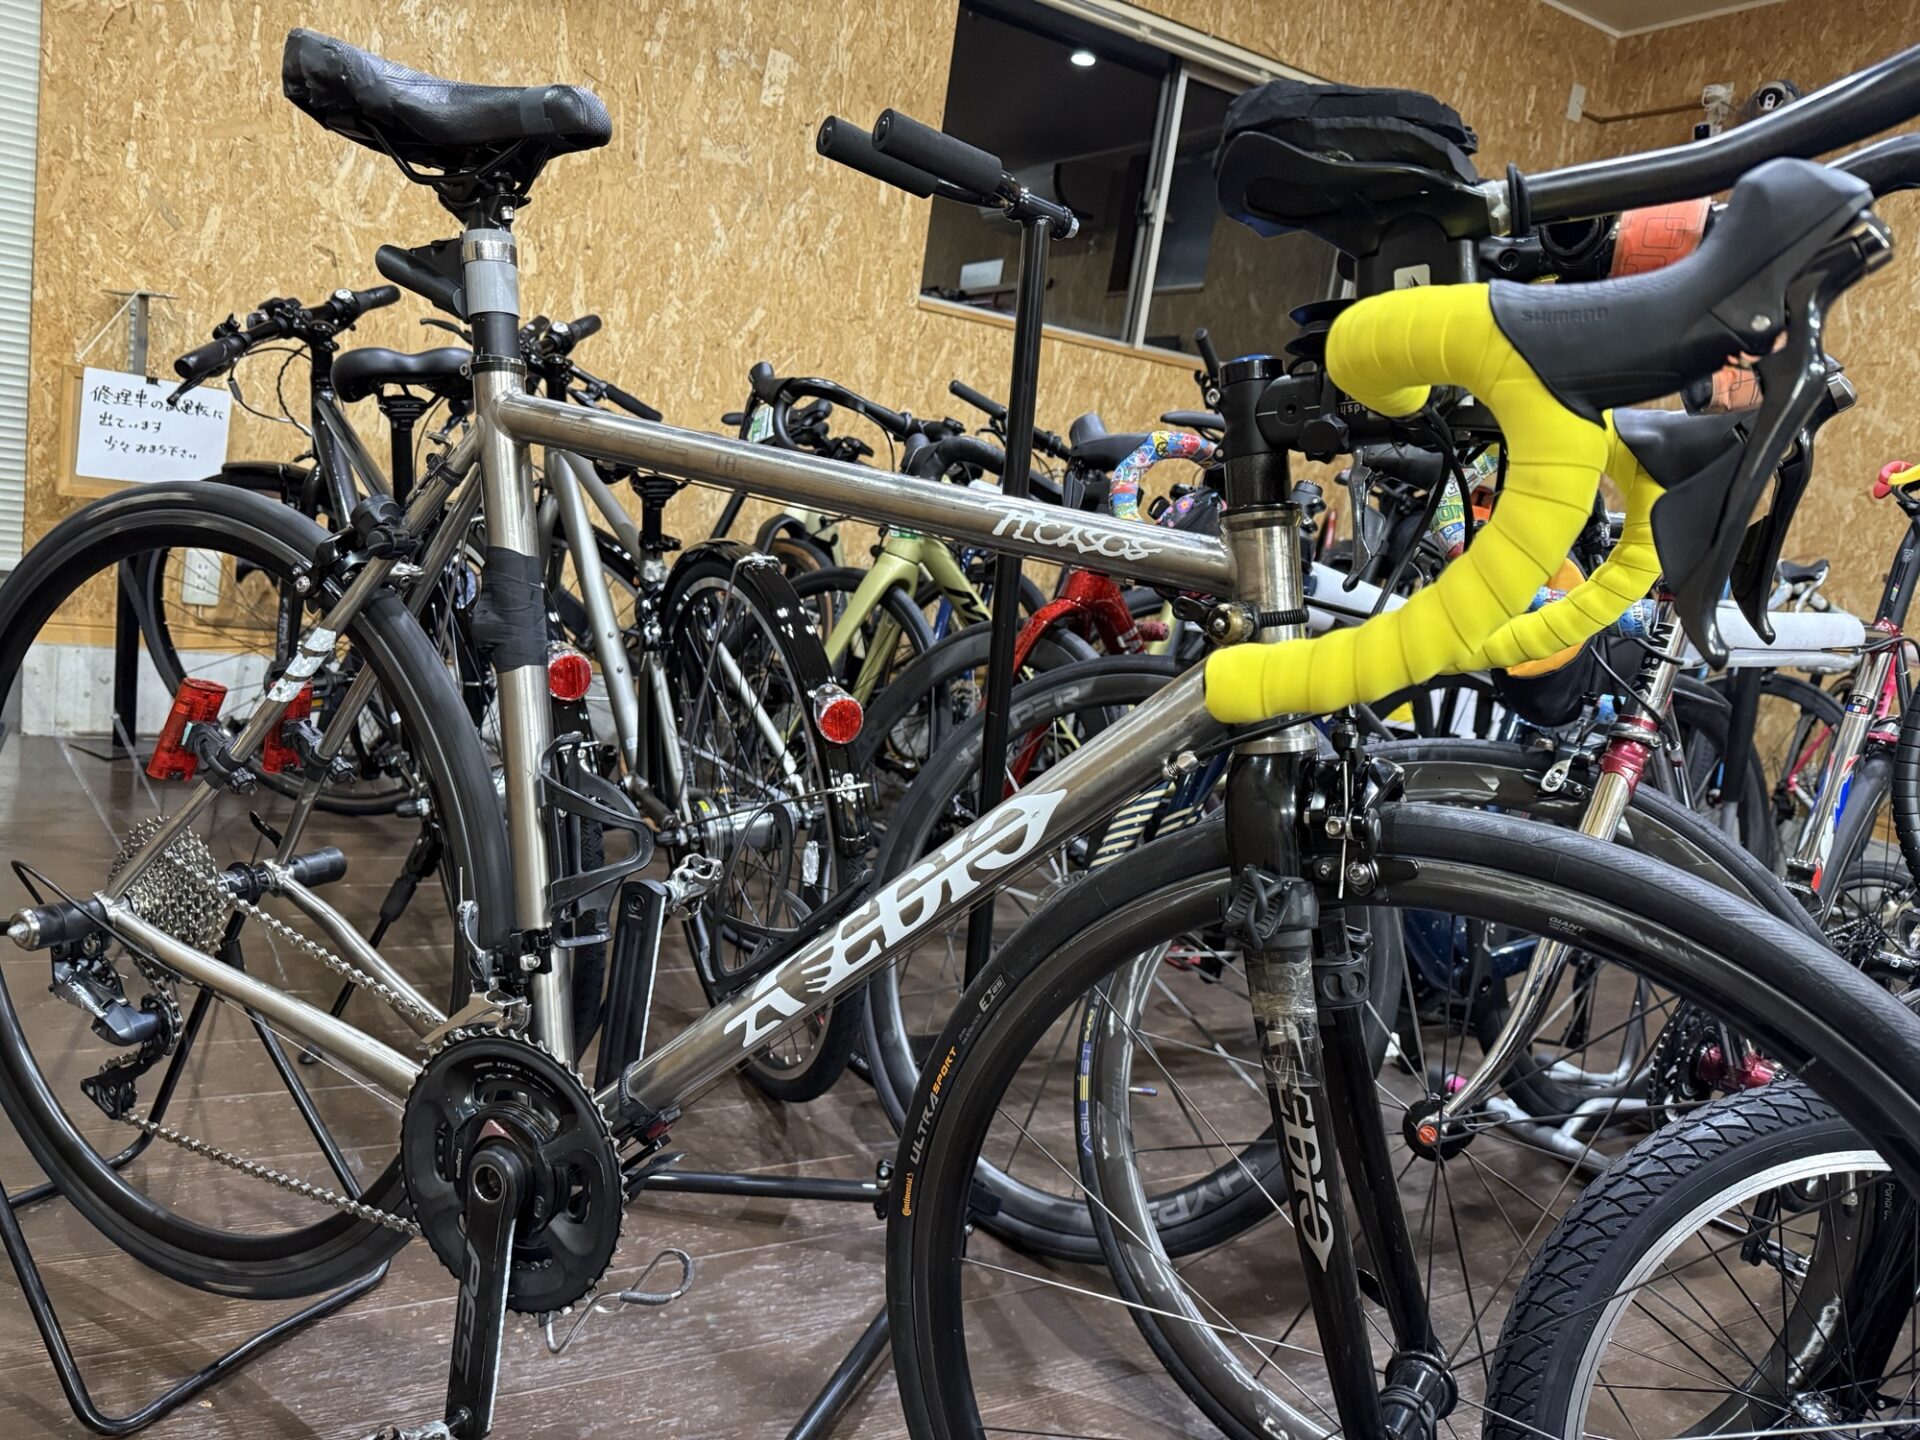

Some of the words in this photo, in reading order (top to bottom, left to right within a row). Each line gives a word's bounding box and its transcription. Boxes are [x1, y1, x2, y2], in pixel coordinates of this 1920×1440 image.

[1520, 307, 1609, 324] SHIMANO
[1632, 622, 1679, 691] MBK
[1079, 1042, 1093, 1157] AGILEST
[902, 1175, 913, 1216] Continental
